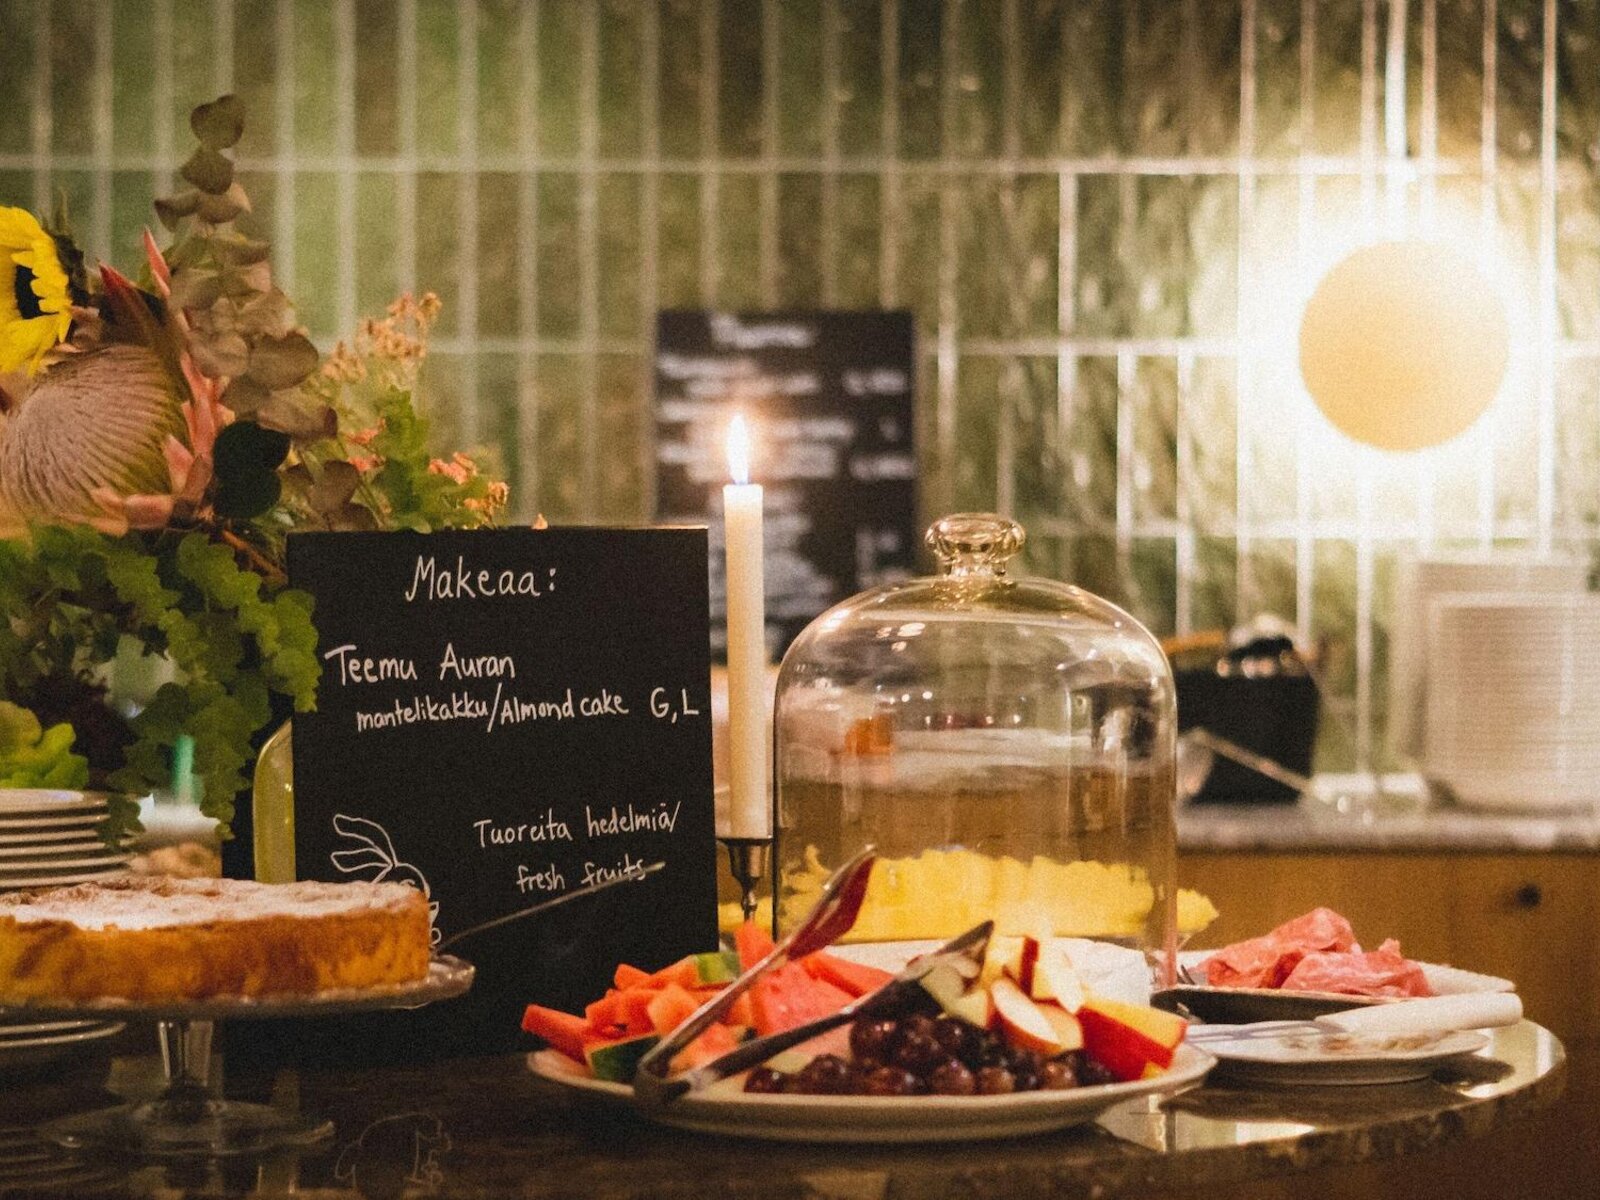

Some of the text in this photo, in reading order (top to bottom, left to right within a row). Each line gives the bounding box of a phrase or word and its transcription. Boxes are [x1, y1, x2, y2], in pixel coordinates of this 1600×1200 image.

[405, 555, 556, 602] Makeaa:
[324, 643, 516, 686] Teemu Auran
[473, 801, 681, 848] Tuoreita hedelmiä/
[516, 853, 647, 894] fresh fruits
